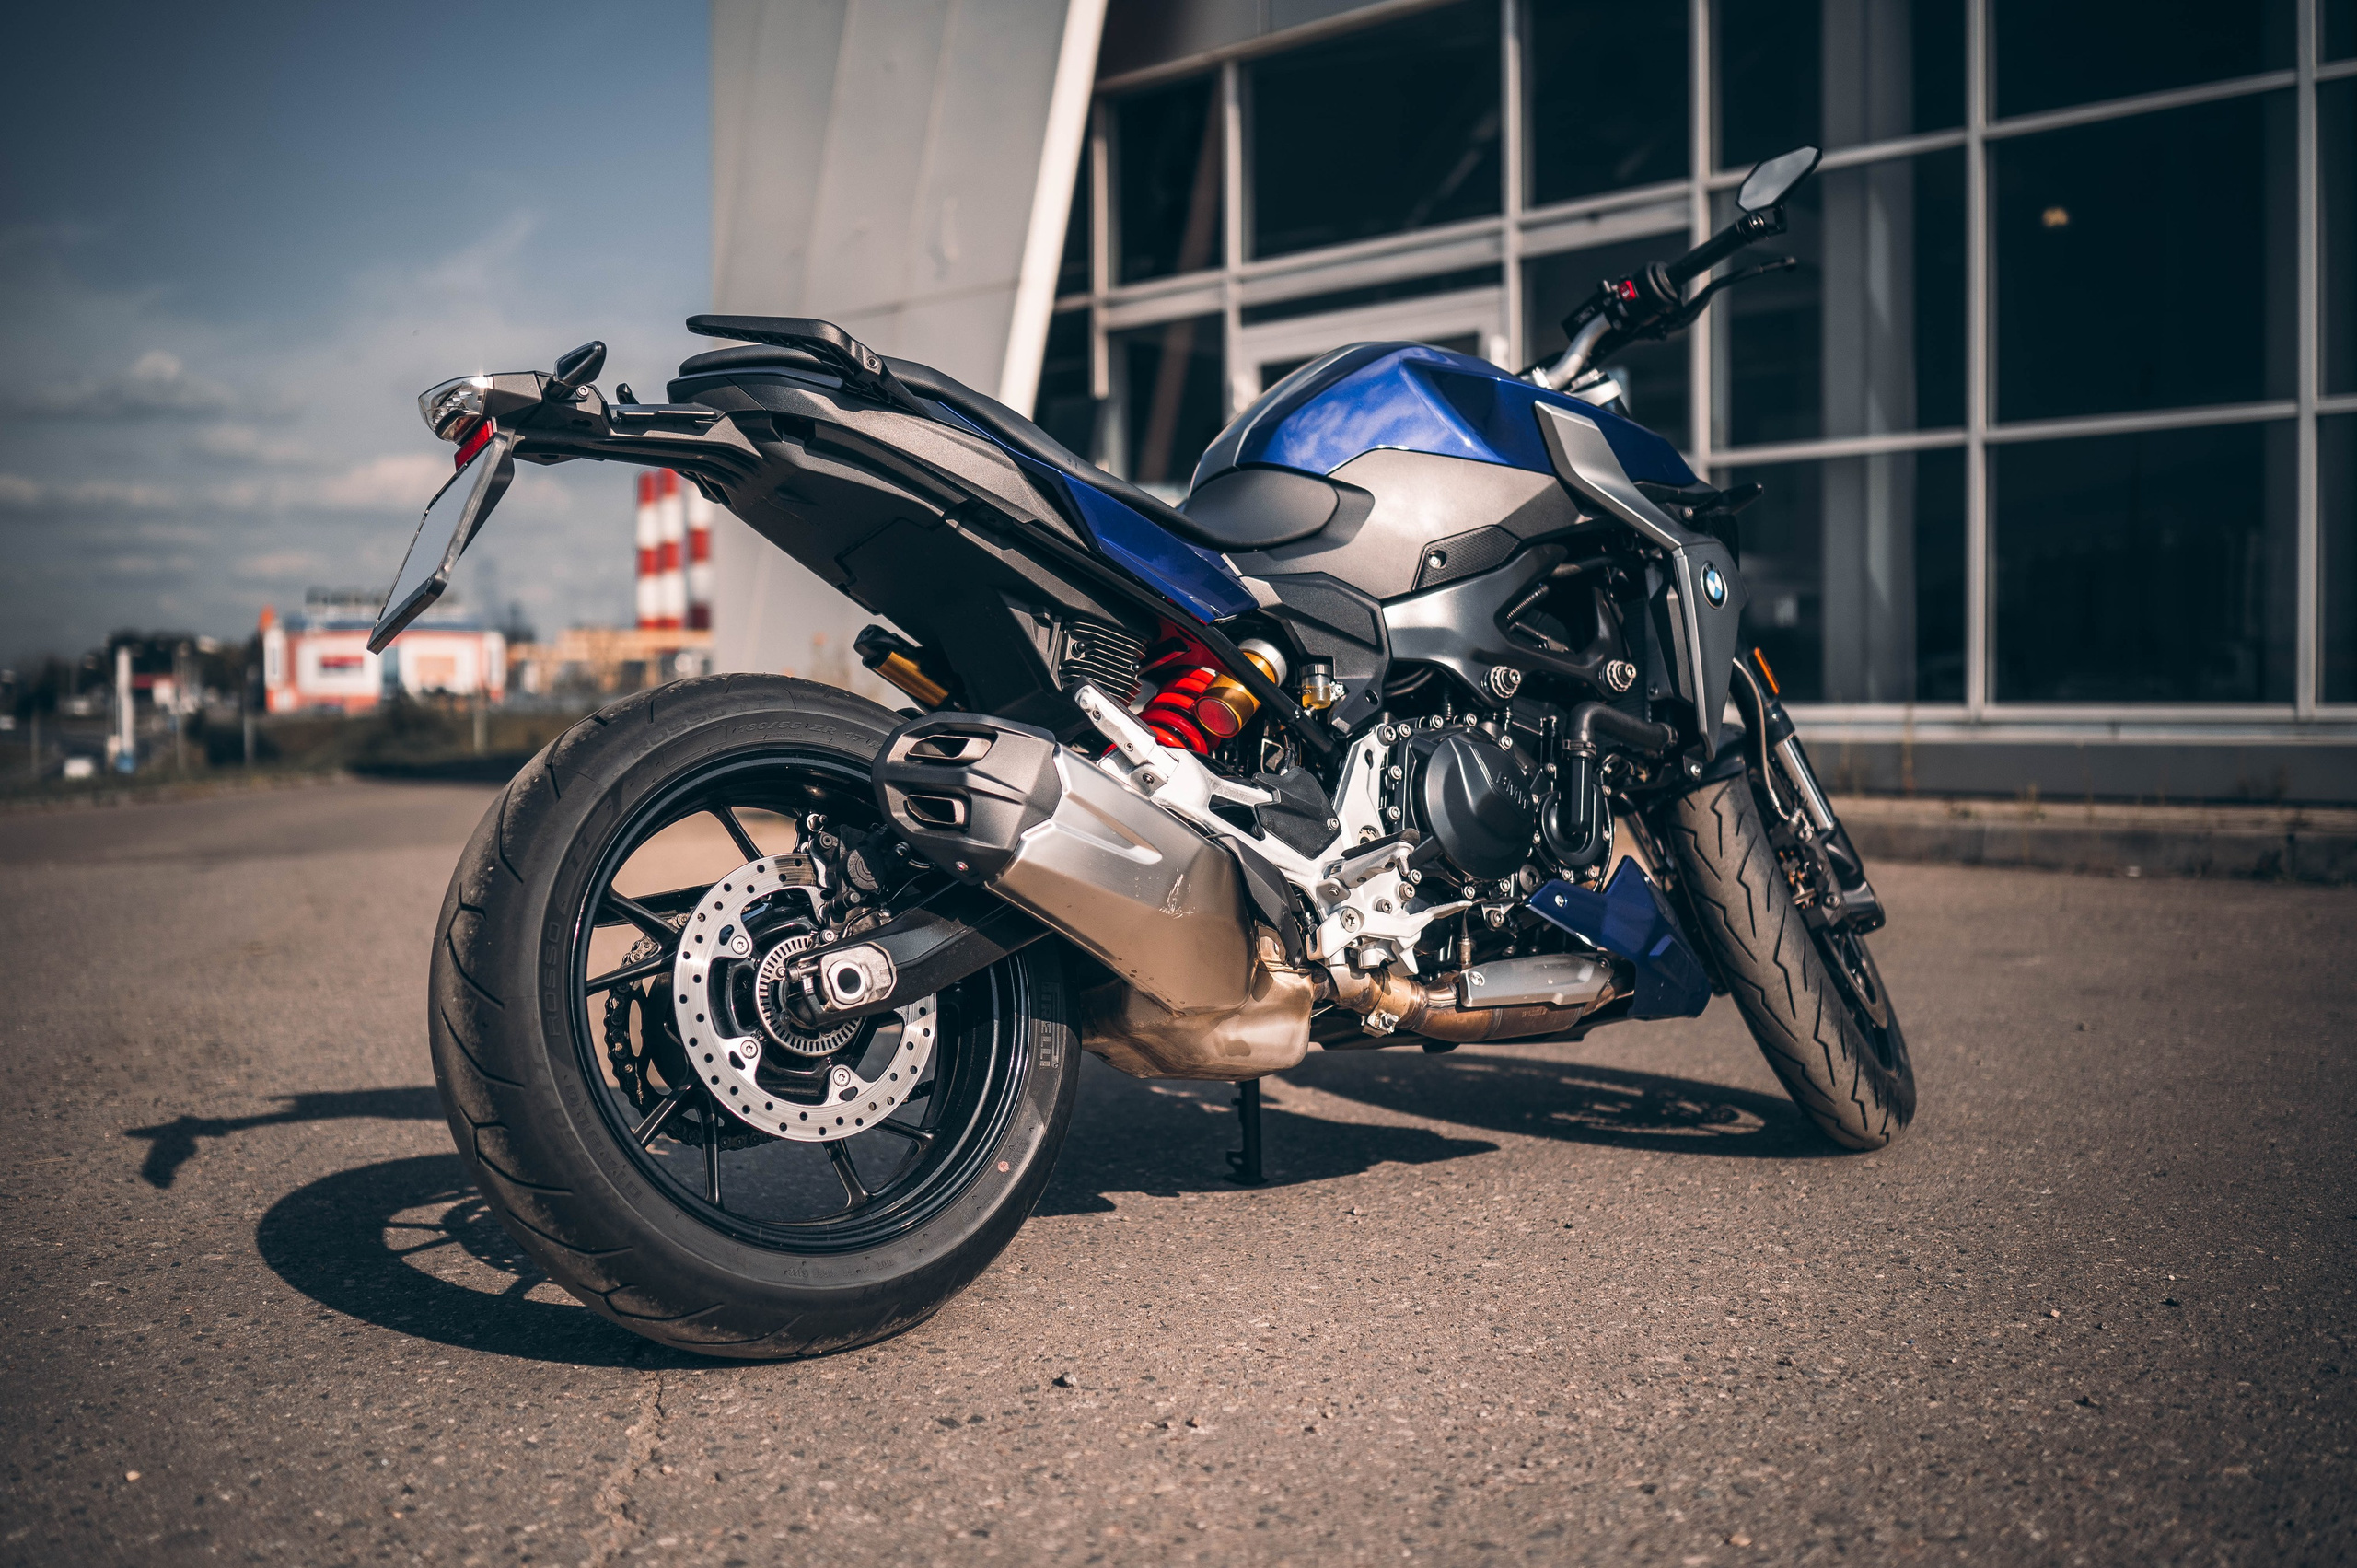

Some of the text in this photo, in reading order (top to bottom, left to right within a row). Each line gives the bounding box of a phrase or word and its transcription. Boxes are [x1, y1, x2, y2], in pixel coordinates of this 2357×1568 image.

[630, 703, 726, 759] ROSSO
[736, 720, 800, 733] 180/55
[809, 722, 836, 735] ZR
[843, 729, 865, 743] 17
[1496, 770, 1530, 810] BMW
[543, 921, 562, 1037] ROSSO
[1039, 981, 1061, 1069] PIRELLI
[563, 1084, 644, 1202] DIABLO
